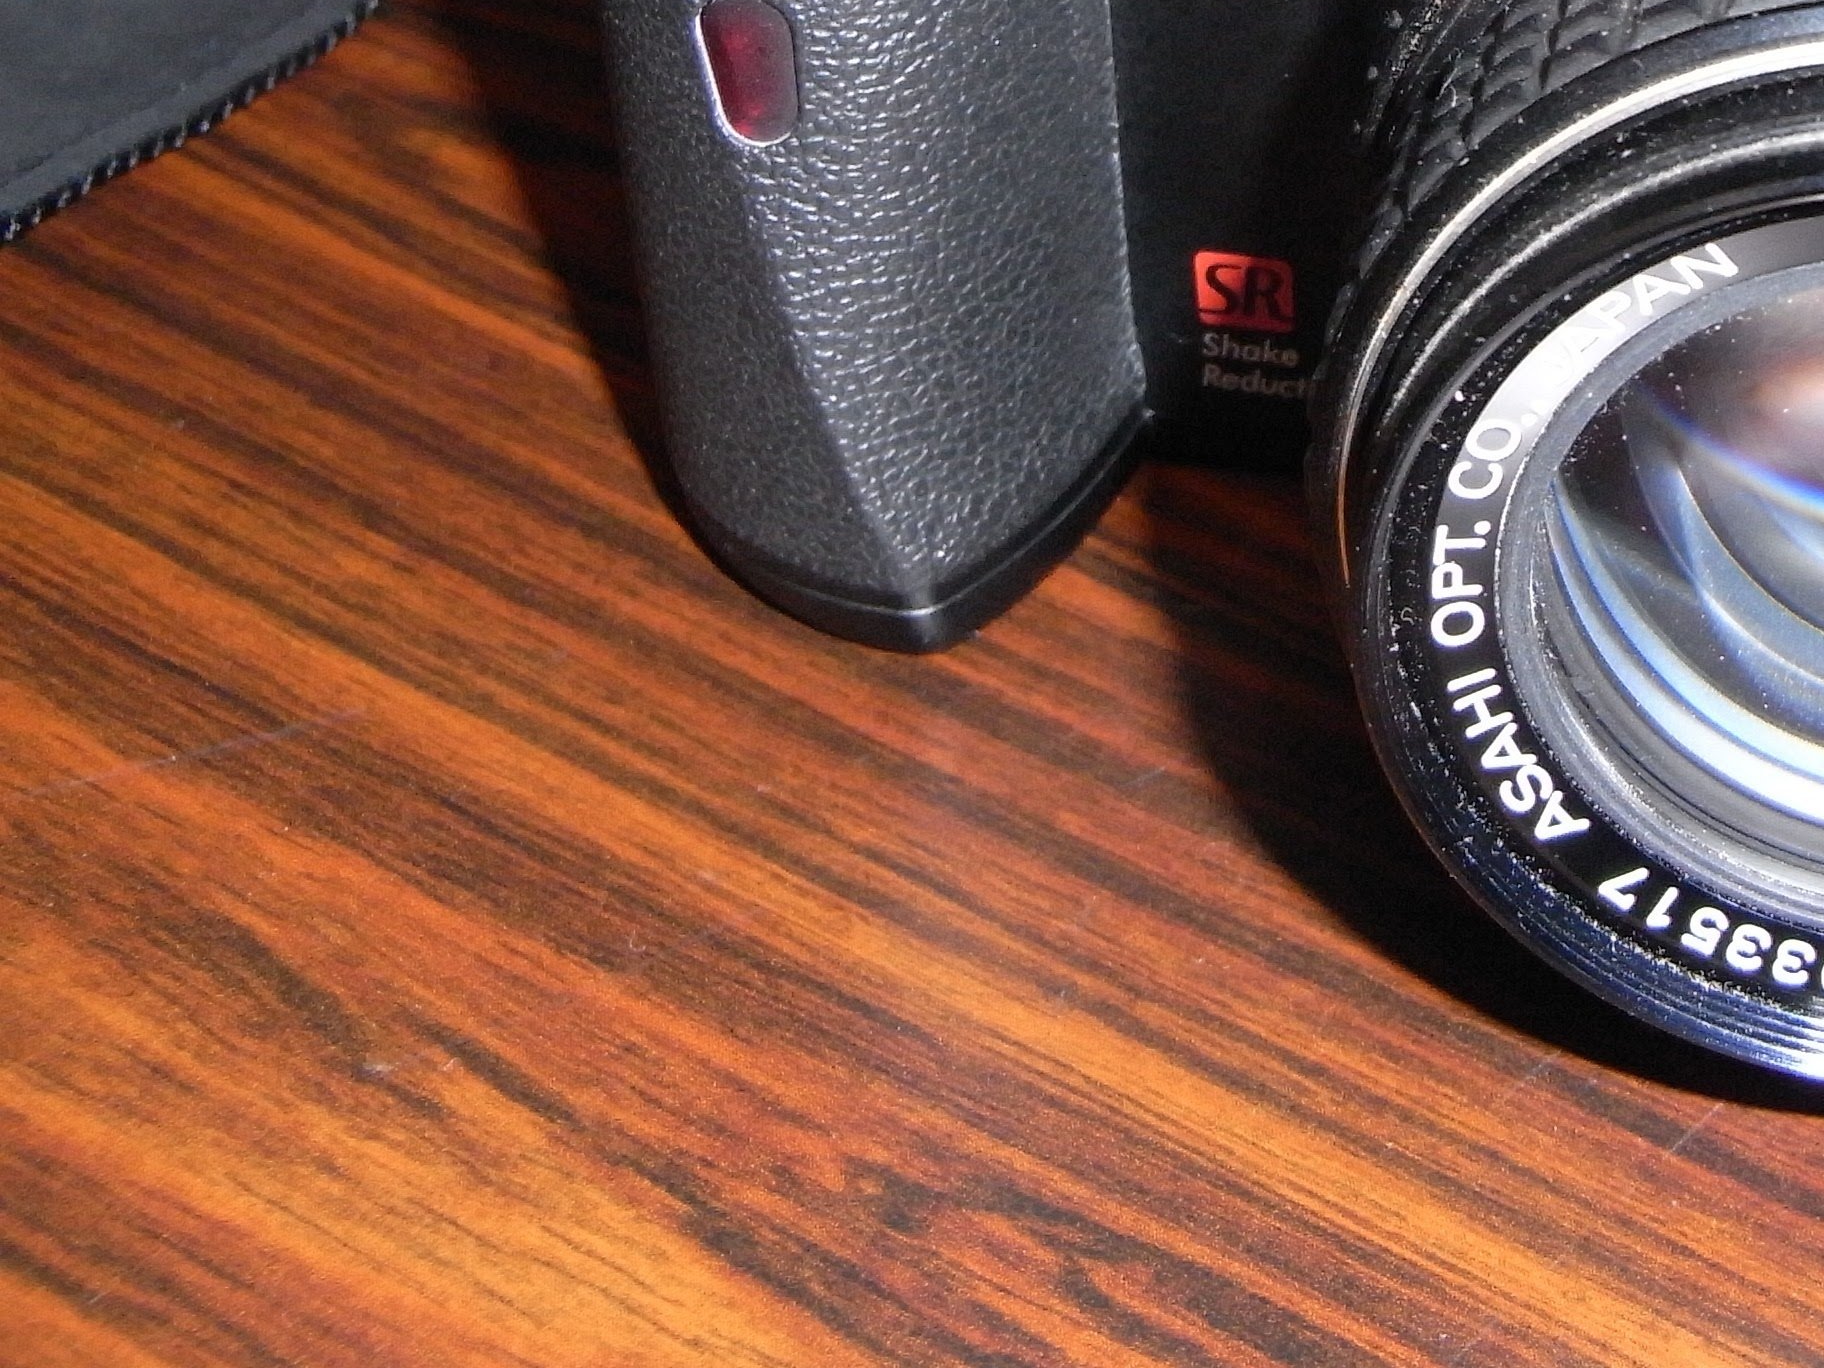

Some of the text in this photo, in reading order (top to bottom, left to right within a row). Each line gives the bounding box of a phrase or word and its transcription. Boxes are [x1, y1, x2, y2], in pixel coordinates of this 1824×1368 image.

[1199, 262, 1297, 322] SR
[1545, 242, 1740, 386] JAPAN
[1202, 332, 1299, 368] Shake
[1203, 363, 1307, 396] Reduct
[1430, 520, 1493, 649] OPT.
[1446, 667, 1592, 843] ASAHI
